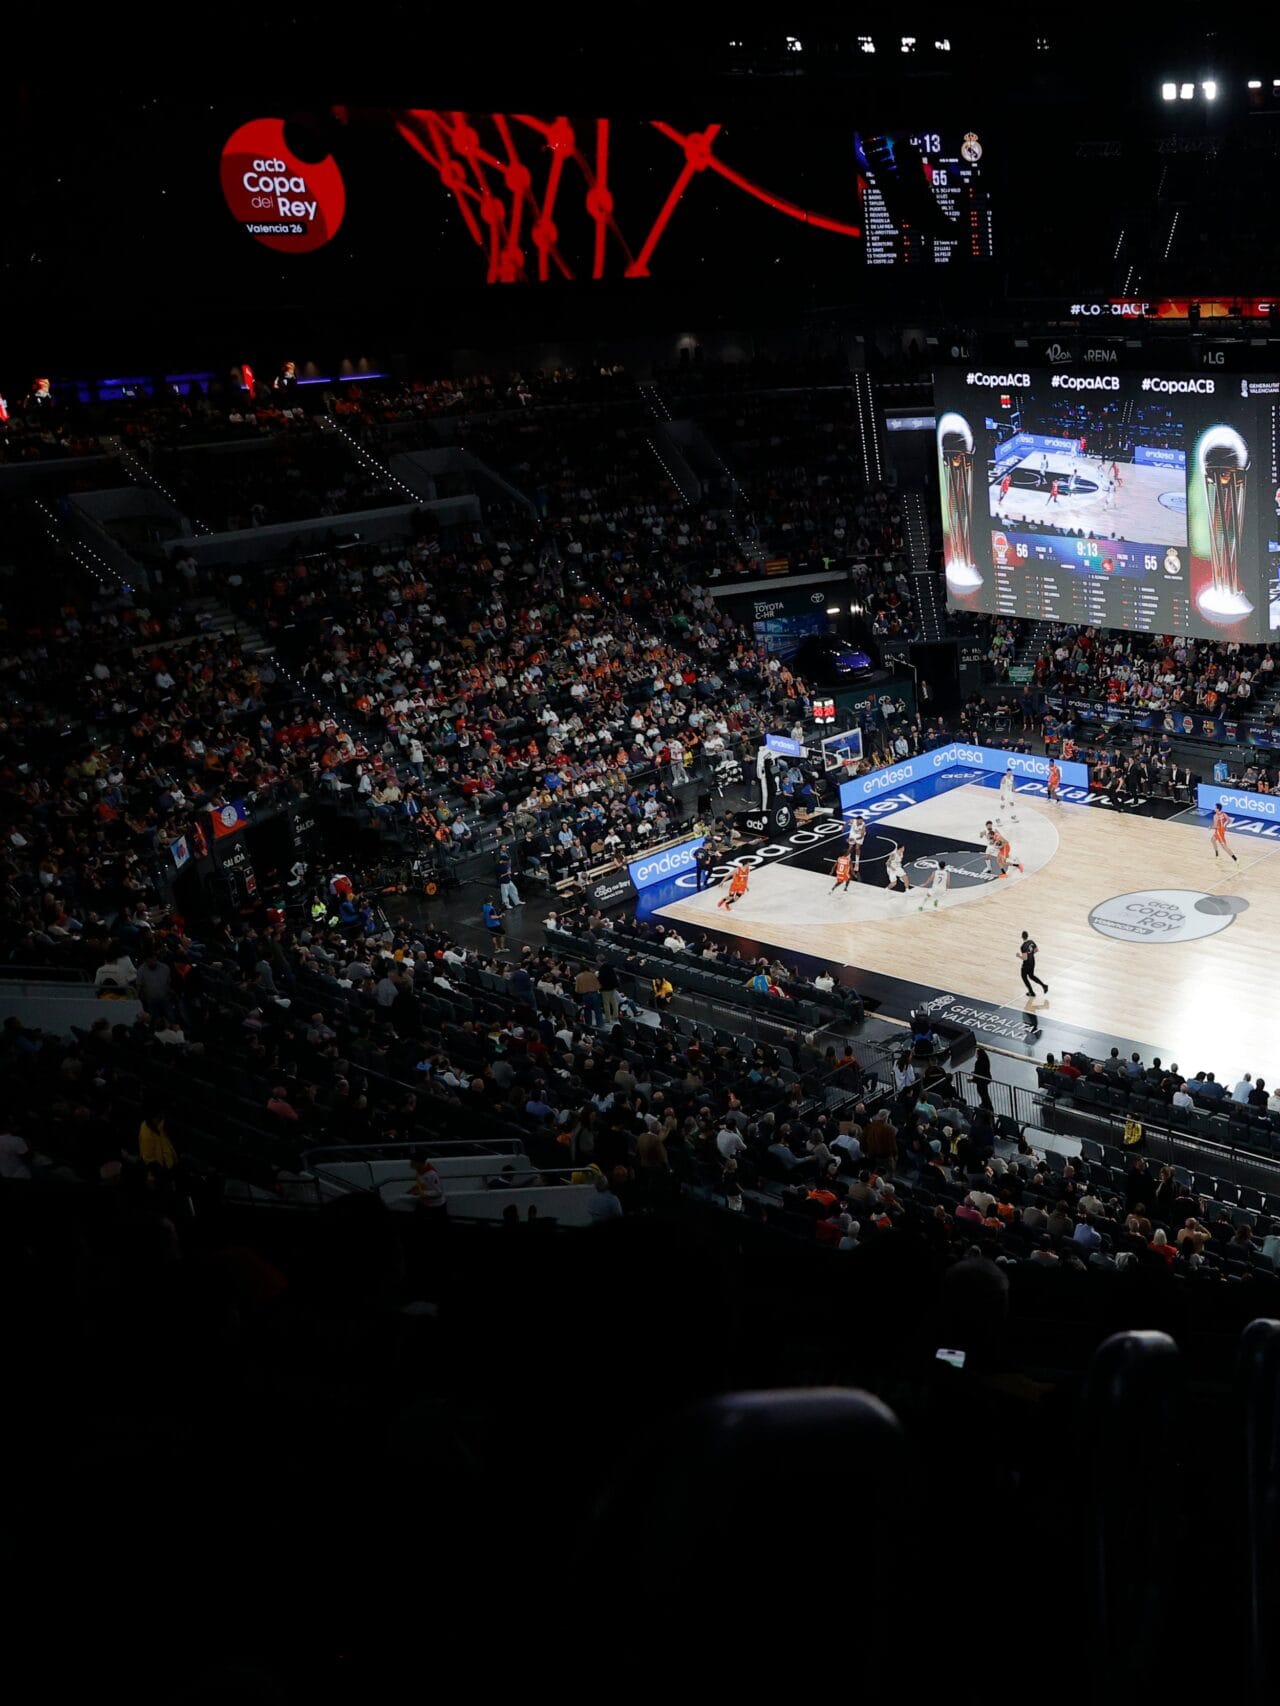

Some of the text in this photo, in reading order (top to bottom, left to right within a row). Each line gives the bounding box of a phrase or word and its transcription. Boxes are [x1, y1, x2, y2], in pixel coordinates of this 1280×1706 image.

[253, 158, 286, 172] acb
[243, 172, 305, 196] Copa
[932, 170, 947, 186] 55
[252, 197, 317, 220] del Rey
[246, 224, 288, 233] Valencia
[1208, 351, 1225, 364] LG
[966, 373, 1031, 387] #CopaACB
[1051, 375, 1120, 391] #CopaACB
[1141, 378, 1215, 394] #CopaACB
[1016, 543, 1028, 558] 56
[1076, 541, 1098, 557] 9:13
[1144, 555, 1158, 571] 55
[754, 602, 784, 613] TOYOTA
[755, 611, 775, 620] C-HR
[771, 740, 795, 750] endesa
[932, 748, 983, 766] endesa
[863, 765, 913, 794] endesa
[1219, 795, 1276, 814] endesa
[746, 815, 764, 830] acb
[789, 818, 846, 845] del
[844, 793, 918, 820] Rey
[223, 853, 246, 868] SALIDA
[937, 876, 943, 884] 7
[1125, 904, 1186, 922] Copa
[1148, 901, 1180, 911] acb
[1137, 917, 1181, 932] Rey
[941, 1011, 1028, 1042] VALENCIANA
[950, 1004, 1042, 1035] GENERALITAT
